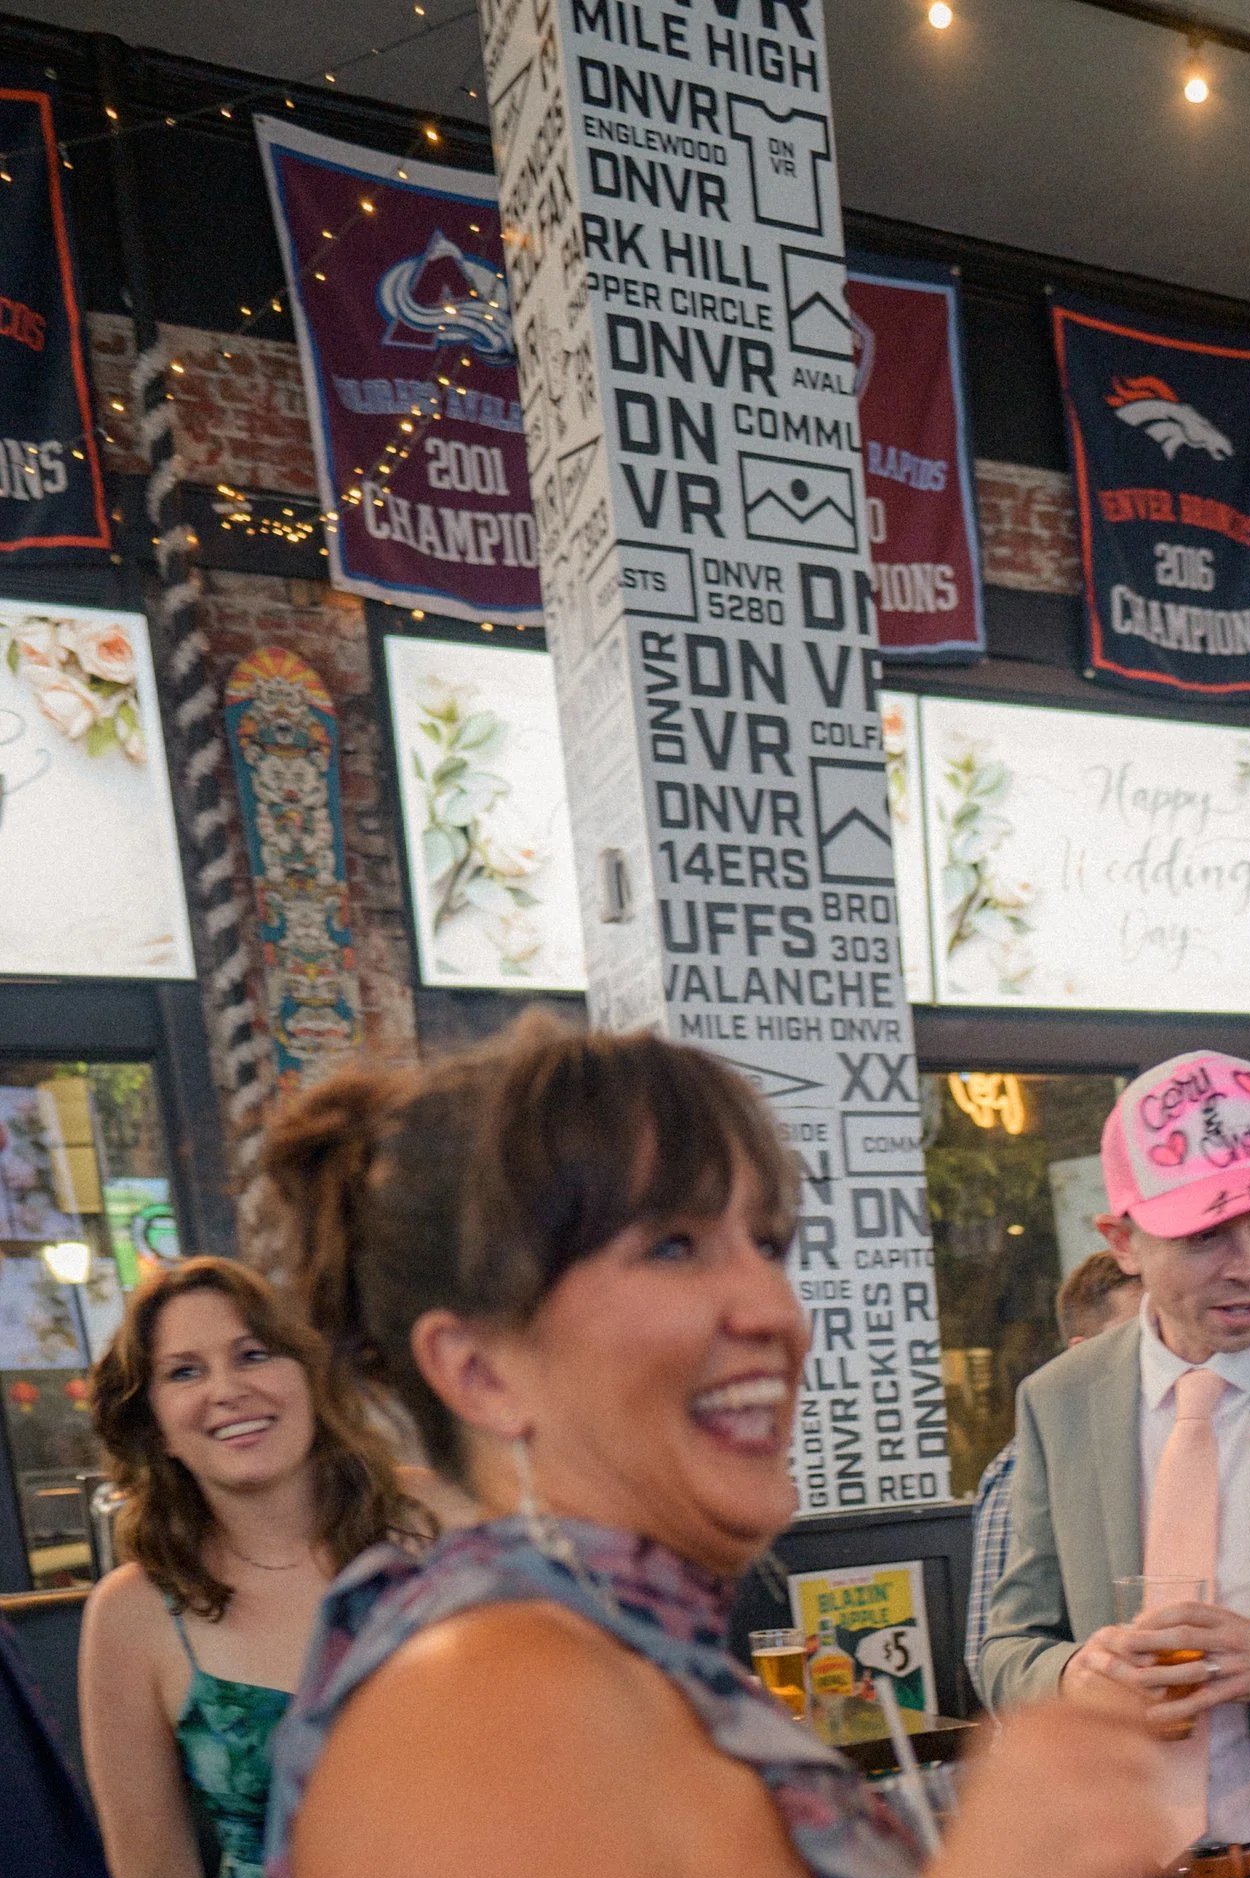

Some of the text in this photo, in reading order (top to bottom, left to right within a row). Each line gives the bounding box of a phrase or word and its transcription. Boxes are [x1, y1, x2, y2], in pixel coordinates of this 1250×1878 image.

[571, 0, 691, 61] MILE
[706, 23, 820, 93] HIGH
[578, 55, 721, 135] DNVR
[583, 114, 727, 166] ENGLEWOOD
[768, 137, 794, 159] DN
[770, 158, 797, 178] VR
[588, 147, 732, 223] DNVR
[661, 228, 768, 292] HILL
[671, 287, 774, 332] CIRCLE
[605, 312, 777, 398] DNVR
[791, 367, 857, 397] AVAL
[613, 387, 718, 465] DN
[424, 436, 511, 497] 2001
[867, 441, 949, 491] RAPIDS
[619, 463, 726, 540] VR
[619, 566, 667, 592] STS
[703, 557, 782, 593] DNVR
[708, 592, 784, 626] 5280
[641, 631, 688, 765] DNVR
[684, 632, 788, 706] DN
[690, 707, 795, 777] VR
[811, 720, 884, 750] COLF
[656, 780, 804, 838] DNVR
[1085, 760, 1236, 836] Happy
[659, 840, 810, 890] 14ERS
[659, 898, 816, 958] UFFS
[821, 891, 899, 925] BRO
[831, 935, 889, 964] 303
[680, 1013, 902, 1043] MILE HIGH DNVR
[801, 1279, 852, 1301] SIDE
[802, 1356, 860, 1392] LL
[863, 1282, 905, 1462] ROCKIES
[908, 1338, 949, 1459] DNVR
[801, 1399, 829, 1508] GOLDEN
[829, 1398, 867, 1507] DNVR
[879, 1472, 938, 1502] RED
